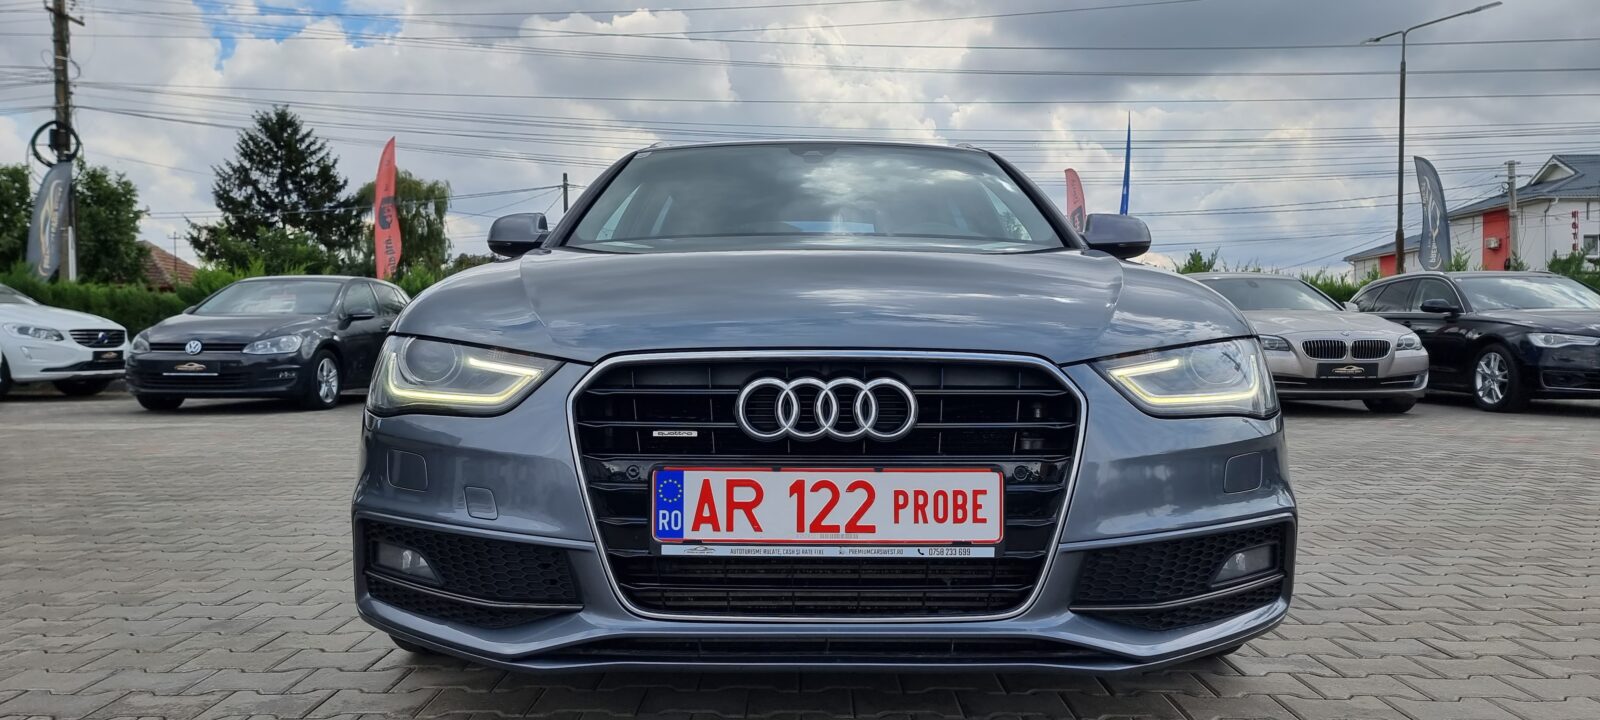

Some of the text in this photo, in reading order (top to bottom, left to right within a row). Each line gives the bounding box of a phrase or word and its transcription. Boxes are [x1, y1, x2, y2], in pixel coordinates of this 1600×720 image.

[691, 478, 988, 534] AR 122 PROBE
[658, 510, 682, 531] RO
[928, 548, 971, 556] 0758 233 699
